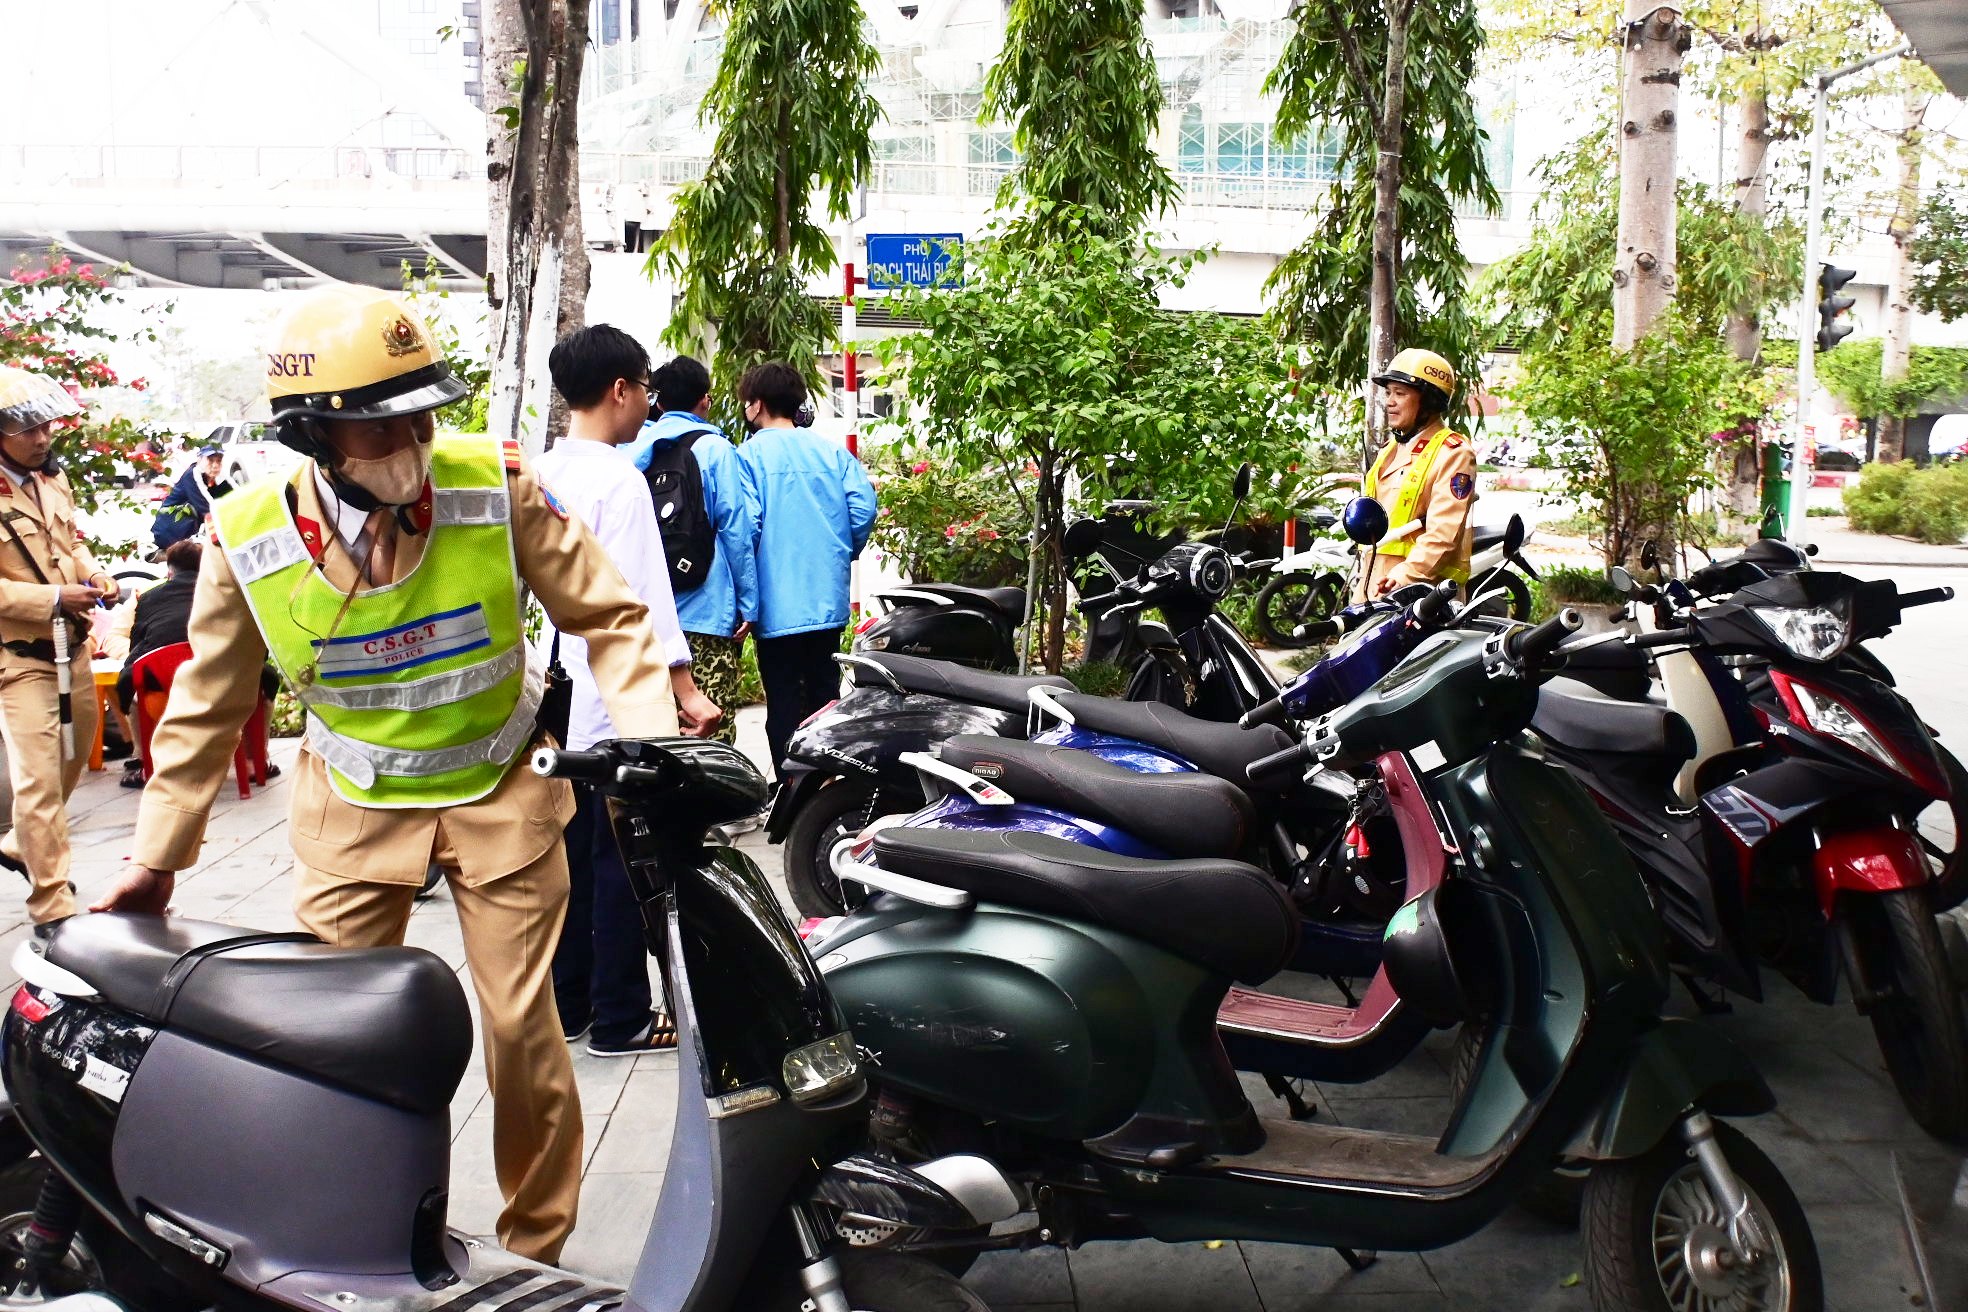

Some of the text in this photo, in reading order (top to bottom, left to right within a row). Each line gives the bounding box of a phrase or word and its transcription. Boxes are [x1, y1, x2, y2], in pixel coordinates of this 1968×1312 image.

[905, 257, 931, 282] THÁI
[364, 624, 436, 654] C.S.G.T
[384, 648, 425, 664] POLICE
